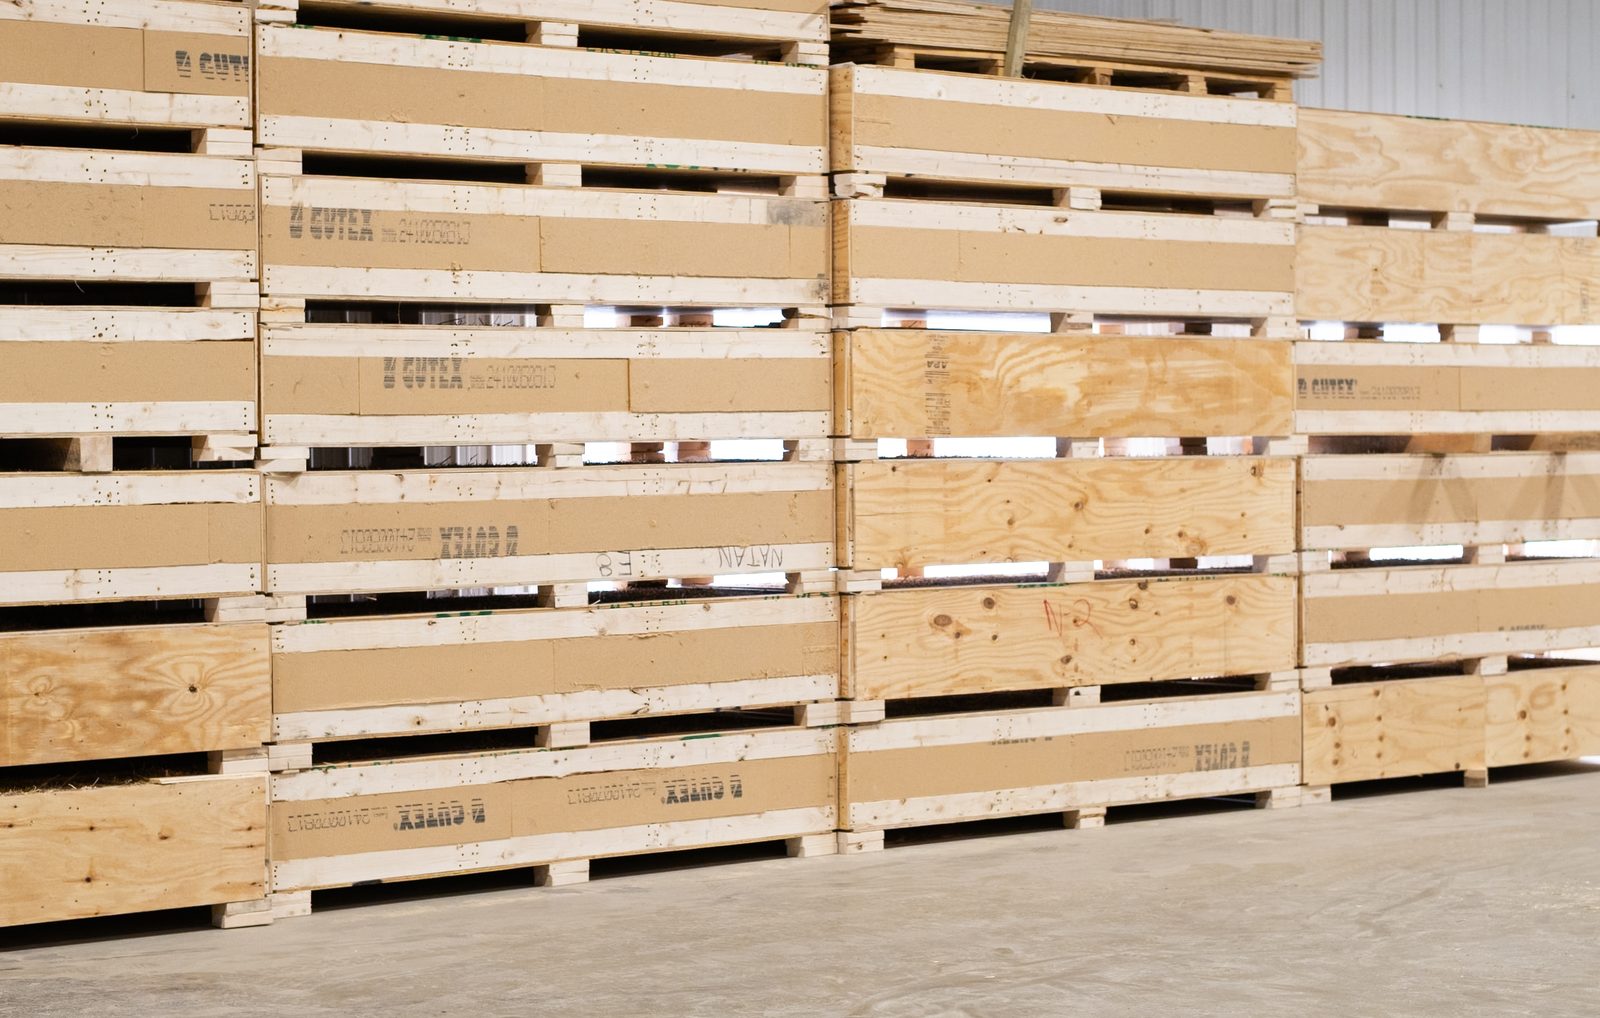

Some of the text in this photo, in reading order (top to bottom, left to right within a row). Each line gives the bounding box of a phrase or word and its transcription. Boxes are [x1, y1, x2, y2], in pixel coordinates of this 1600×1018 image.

[310, 206, 374, 242] GUTEX
[402, 357, 463, 389] GUTEX
[1311, 378, 1356, 400] GUTEX
[439, 525, 500, 558] GUTEX
[718, 545, 783, 568] NATAN
[1194, 743, 1237, 772] GUTEX
[663, 776, 724, 805] GUTEX
[396, 800, 464, 831] GUTEX
